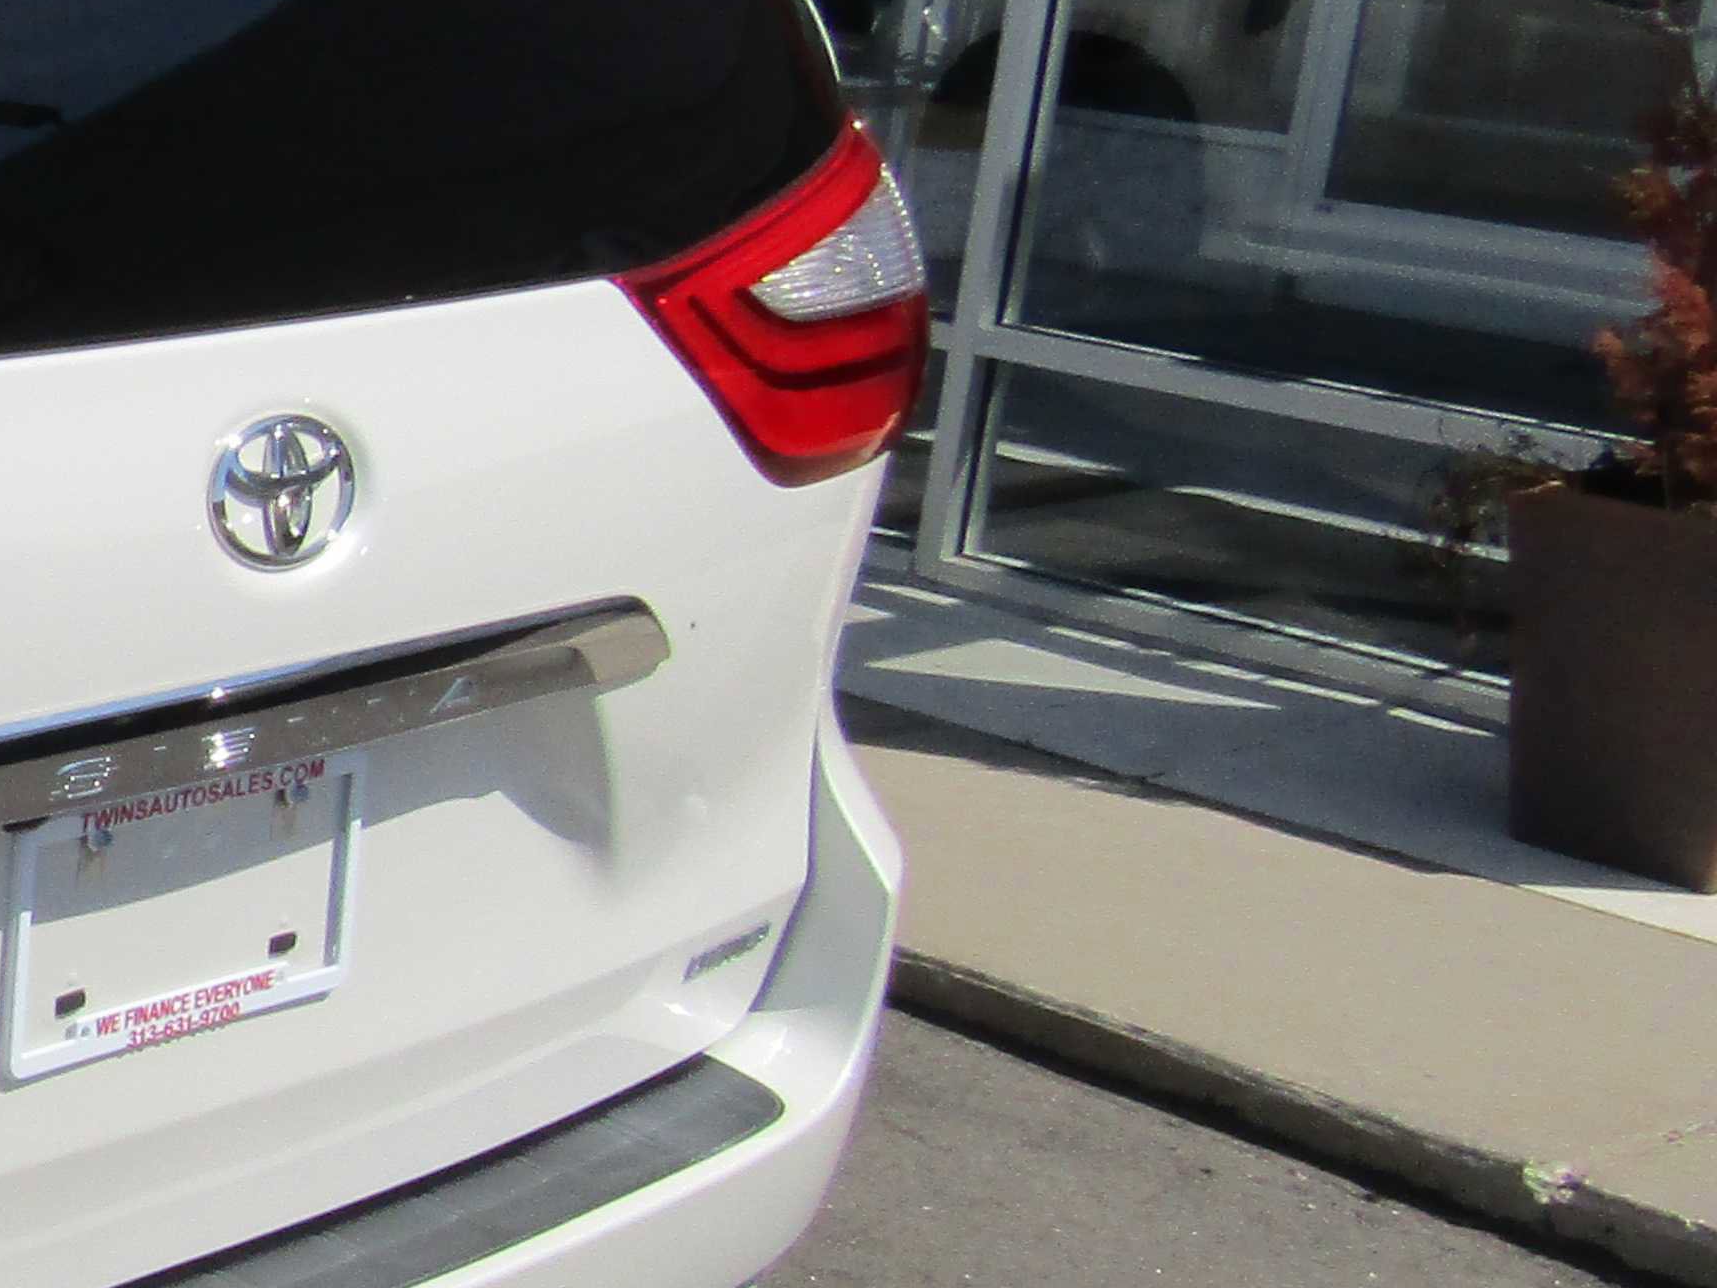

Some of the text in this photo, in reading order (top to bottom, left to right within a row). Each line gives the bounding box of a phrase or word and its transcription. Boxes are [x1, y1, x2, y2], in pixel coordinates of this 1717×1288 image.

[82, 760, 325, 832] TWINSAUTOSALES.COM
[96, 969, 276, 1037] WE FINANCE EVERYONE
[127, 1002, 241, 1048] 313-631-9700
